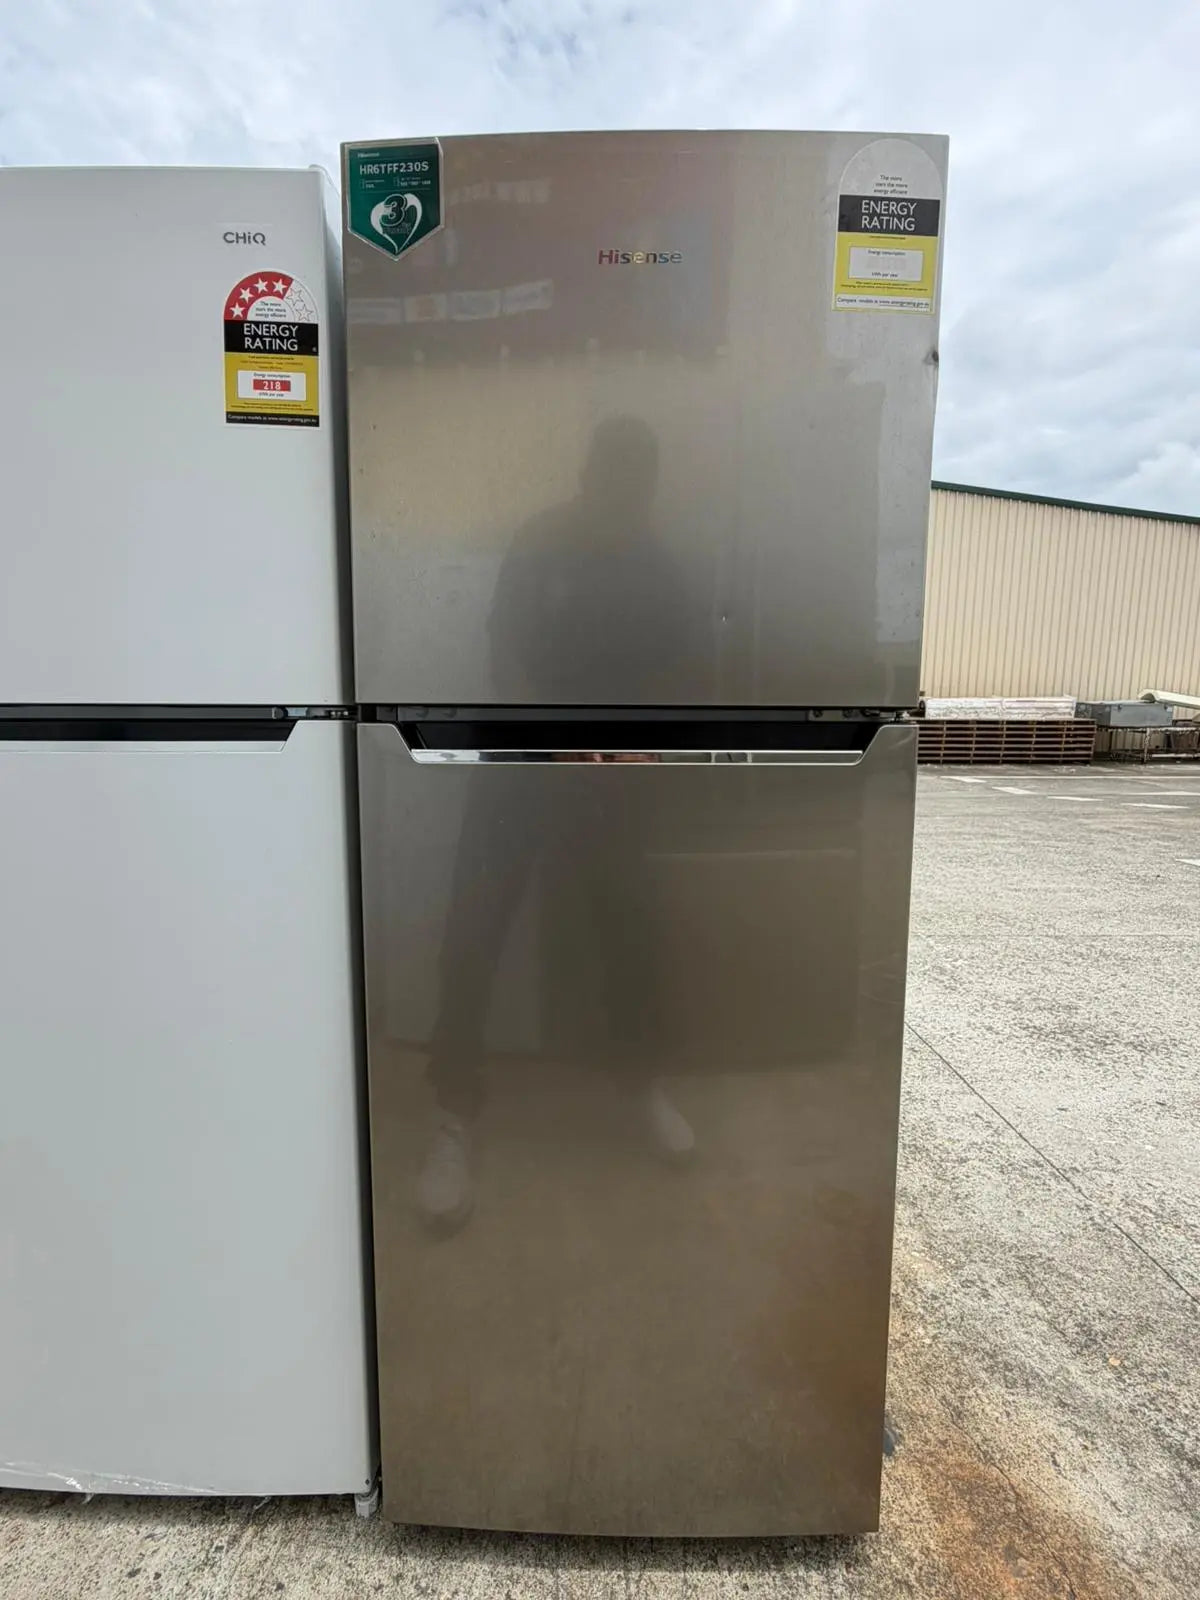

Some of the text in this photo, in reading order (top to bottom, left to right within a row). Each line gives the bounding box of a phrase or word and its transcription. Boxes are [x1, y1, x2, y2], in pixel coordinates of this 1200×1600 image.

[360, 161, 429, 175] HR6TFF230S
[861, 200, 917, 215] ENERGY
[861, 216, 916, 231] RATING
[223, 232, 266, 246] CHiQ
[598, 249, 682, 265] Hisense
[244, 324, 299, 337] ENERGY
[244, 338, 298, 351] RATING
[262, 380, 281, 390] 218
